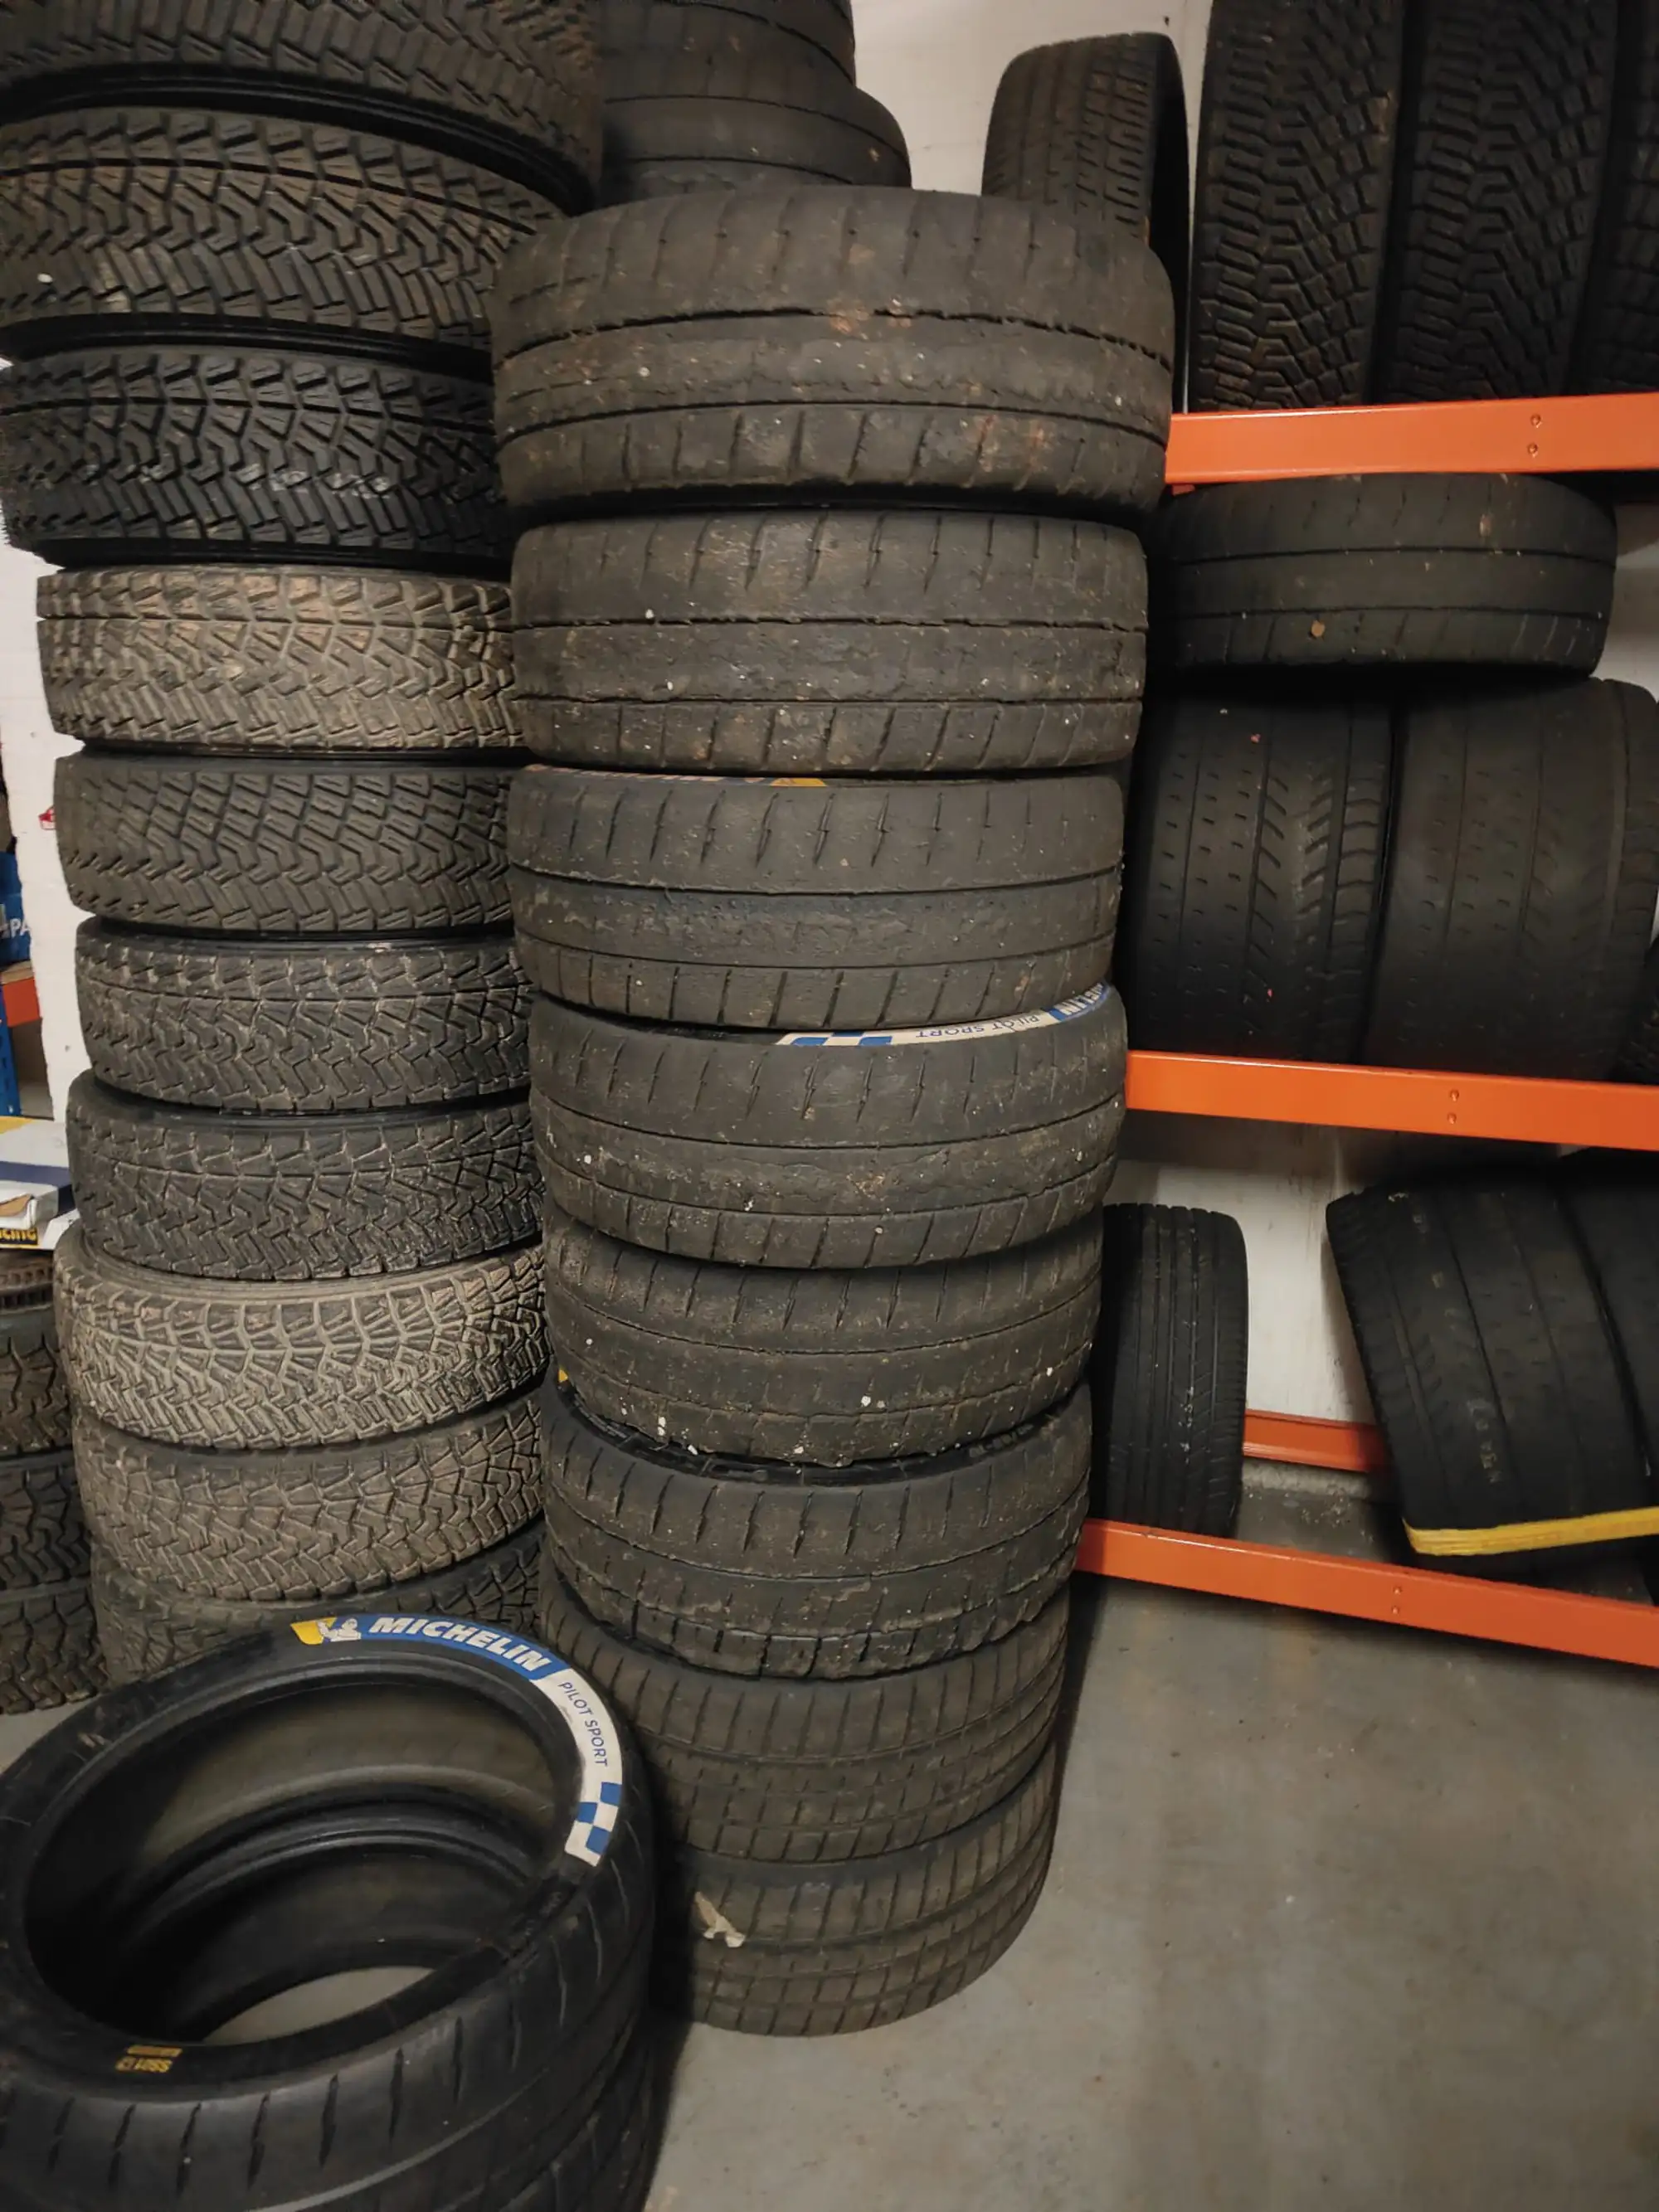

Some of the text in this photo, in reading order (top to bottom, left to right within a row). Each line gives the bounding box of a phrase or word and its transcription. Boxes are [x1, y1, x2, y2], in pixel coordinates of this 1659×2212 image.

[915, 1015, 1040, 1038] PILOT SPORT
[369, 1617, 551, 1672] MICHELIN
[558, 1682, 607, 1767] PILOT SPORT
